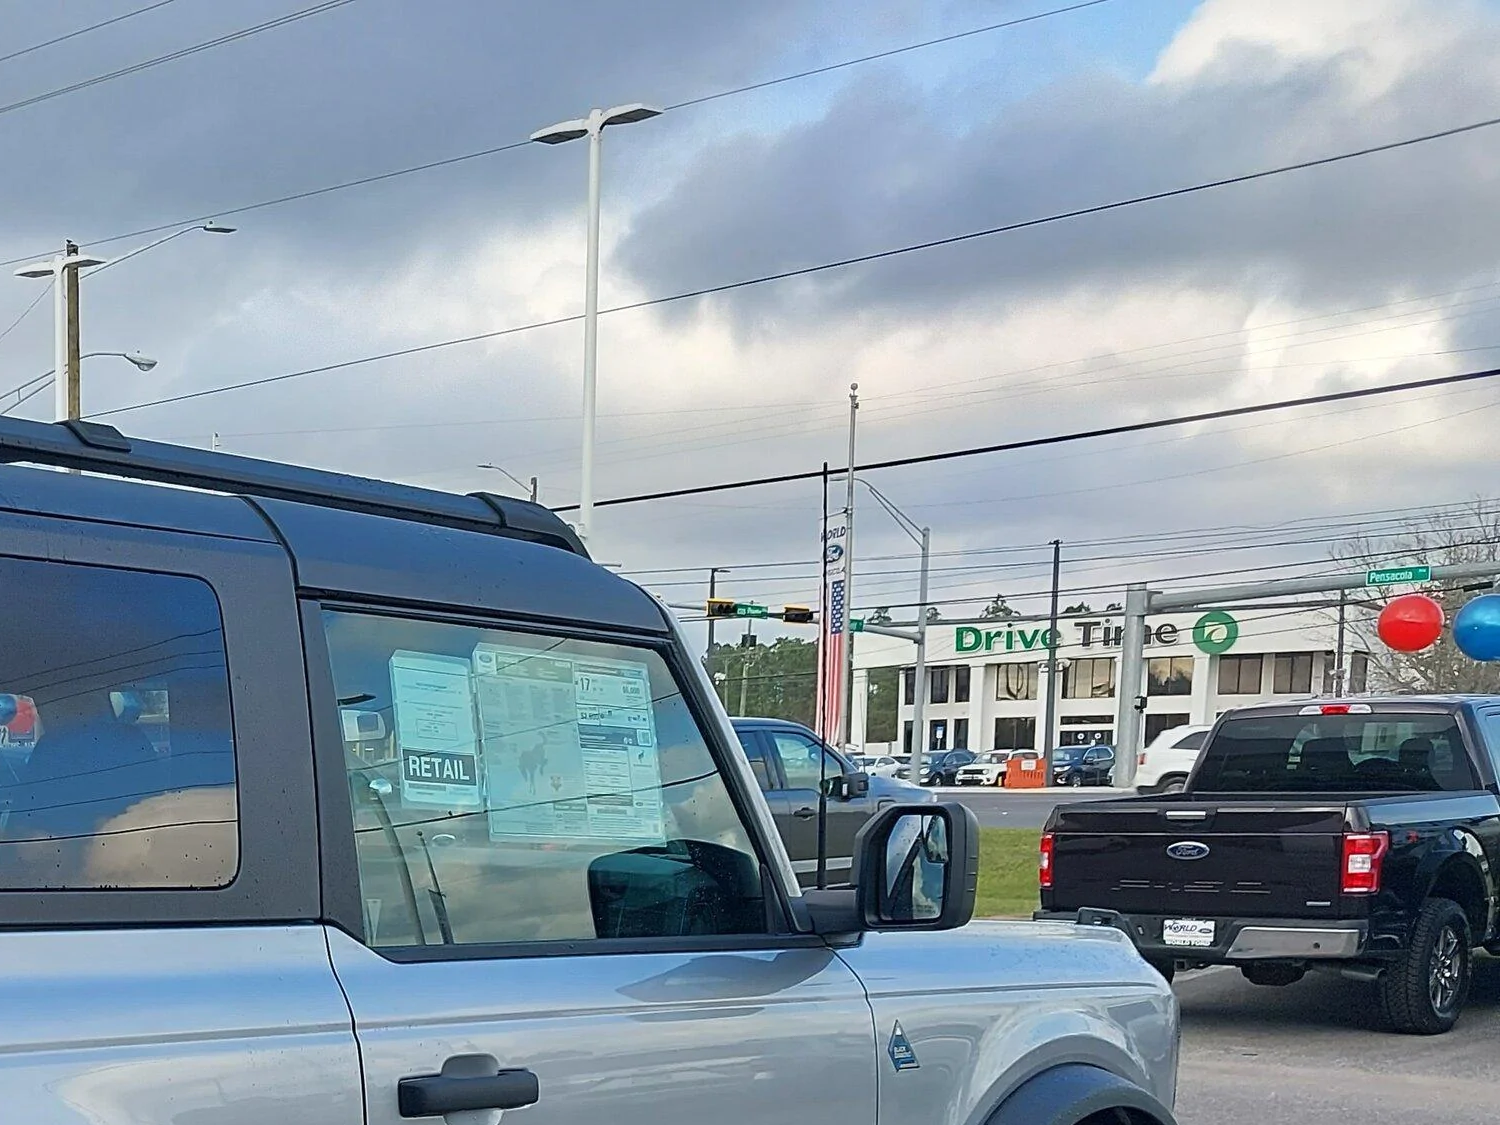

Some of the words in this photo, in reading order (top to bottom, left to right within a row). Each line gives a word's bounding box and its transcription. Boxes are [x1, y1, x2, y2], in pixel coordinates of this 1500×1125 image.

[1369, 571, 1413, 582] Pensacola
[955, 623, 1062, 652] Drive
[580, 677, 590, 691] 17
[408, 755, 470, 781] RETAIL
[1164, 922, 1198, 933] WORLD
